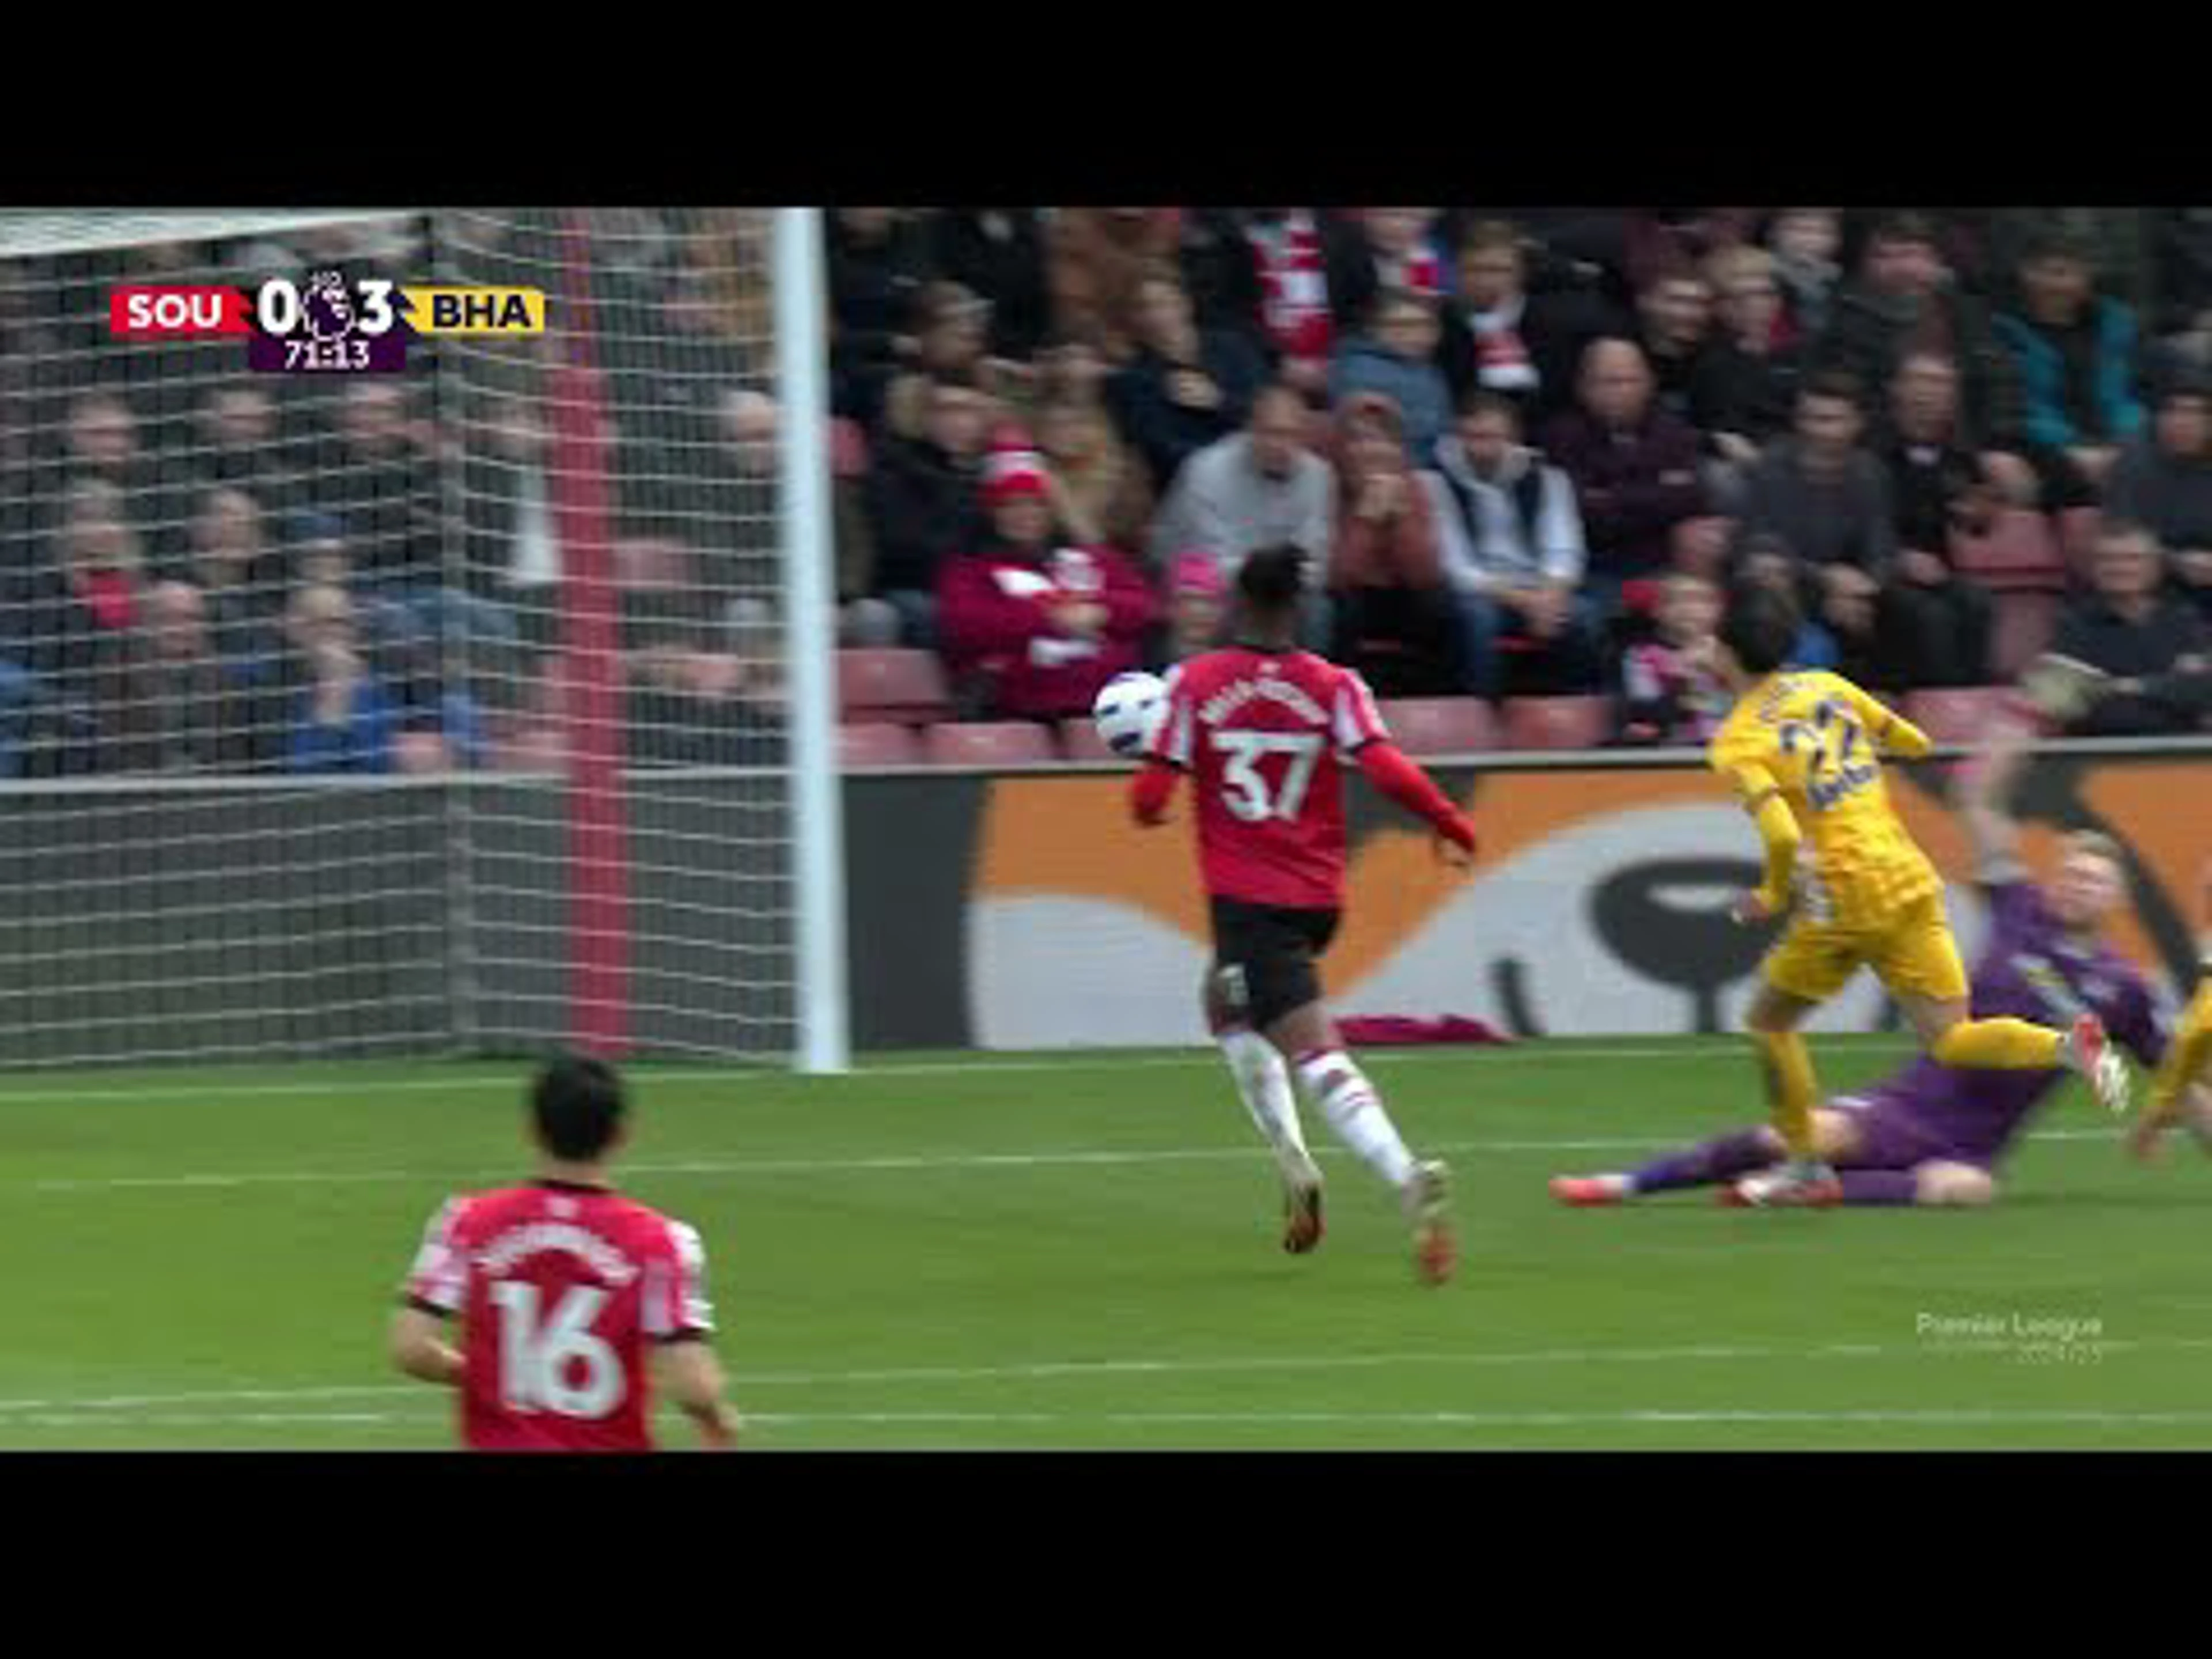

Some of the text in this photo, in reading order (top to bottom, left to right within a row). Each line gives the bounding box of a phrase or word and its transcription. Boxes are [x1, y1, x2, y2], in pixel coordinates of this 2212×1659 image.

[1213, 730, 1324, 821] 37
[1779, 699, 1872, 779] 22
[491, 1280, 624, 1418] 16
